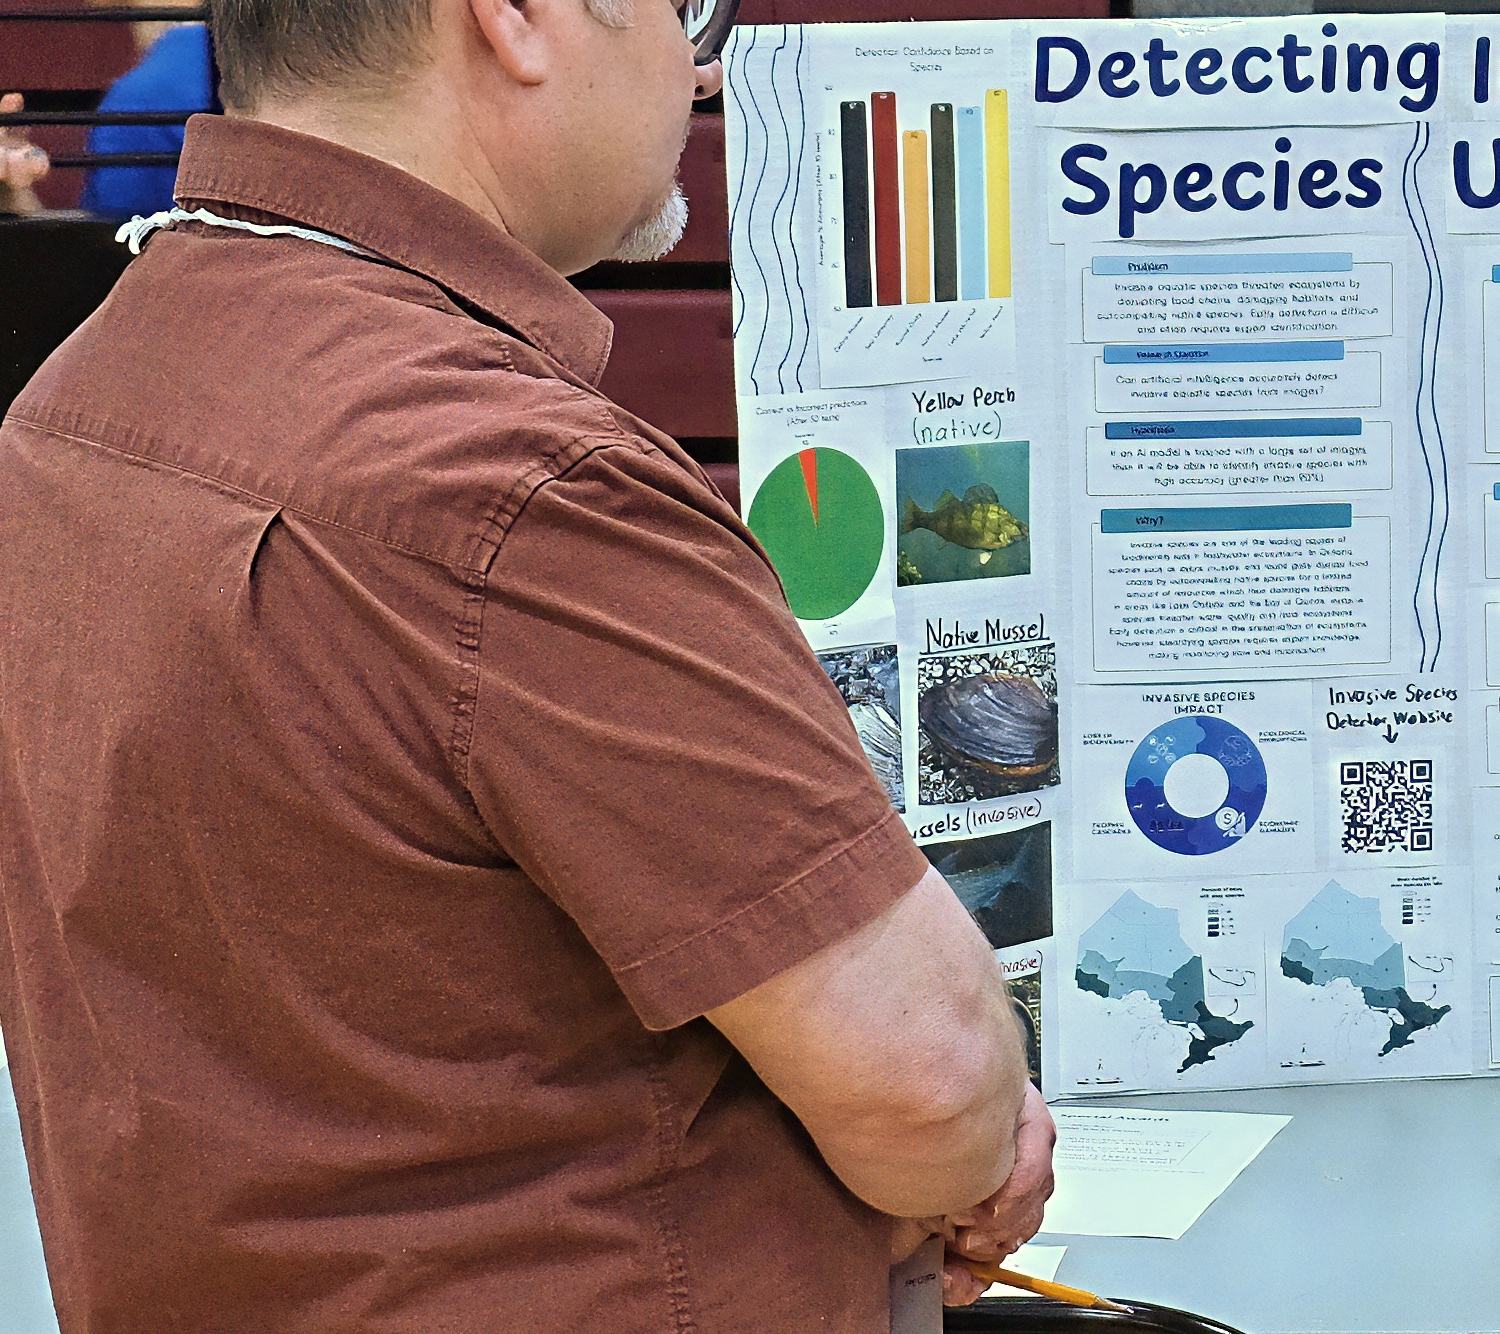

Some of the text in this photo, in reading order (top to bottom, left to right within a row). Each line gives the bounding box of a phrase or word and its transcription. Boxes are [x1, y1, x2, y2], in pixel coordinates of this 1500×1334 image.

[1034, 22, 1442, 113] Detecting
[1060, 136, 1383, 238] Species
[912, 386, 1015, 414] Yellow Perch
[913, 410, 1002, 445] (native)
[926, 613, 1044, 652] Native Mussel
[1142, 691, 1255, 703] INVASIVE SPECIES
[1329, 683, 1458, 705] Invasive Species
[911, 813, 961, 840] ssels
